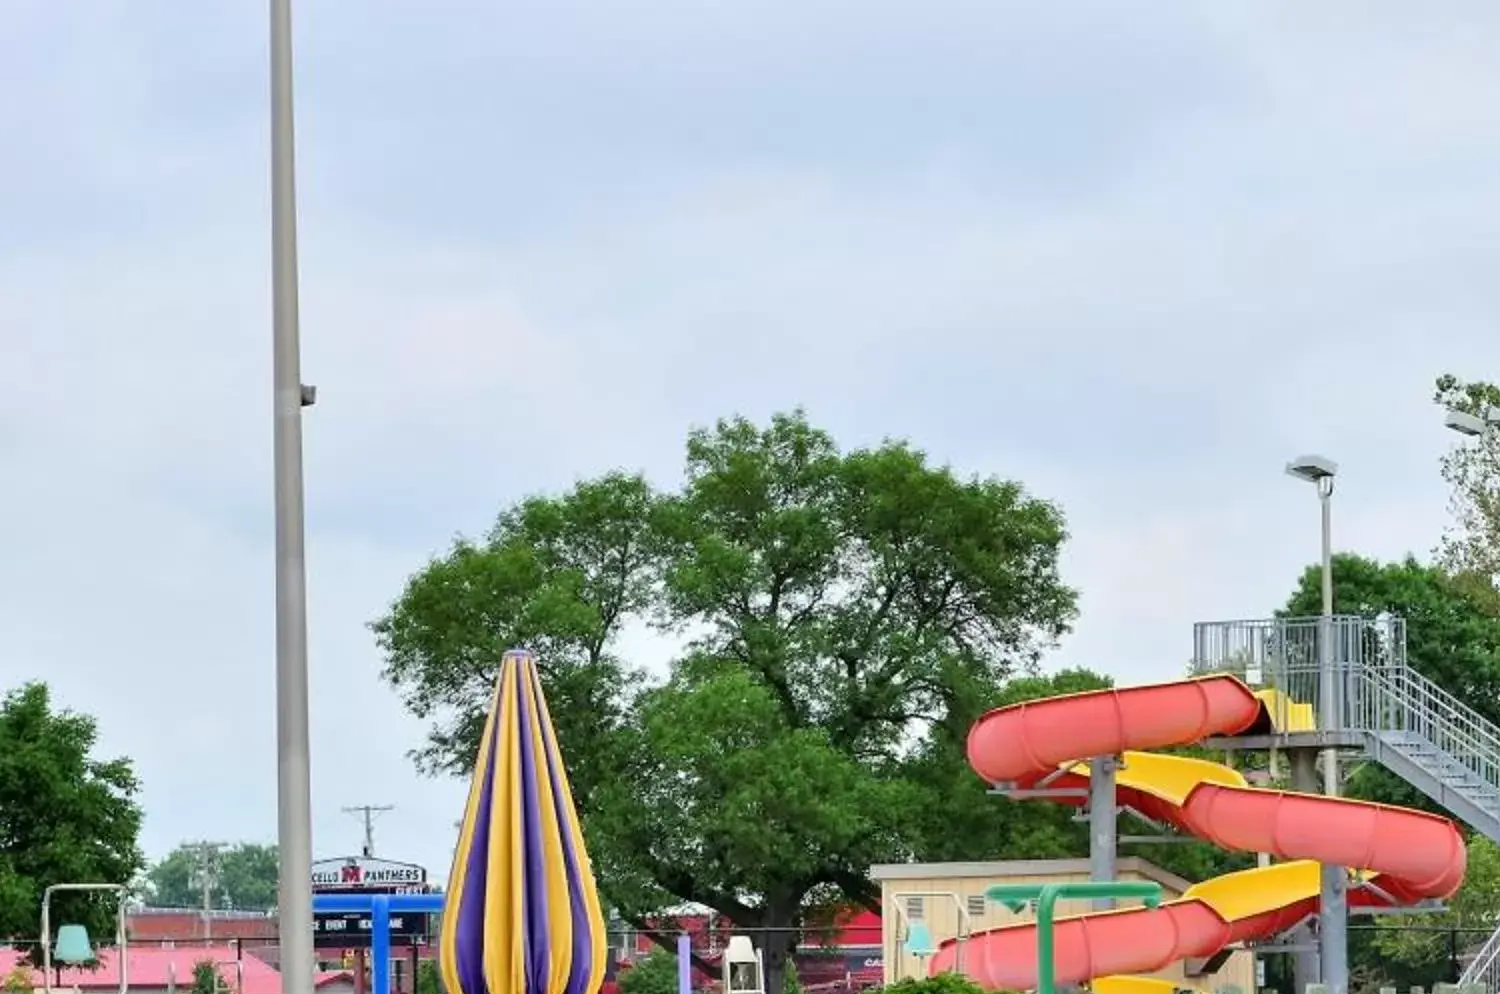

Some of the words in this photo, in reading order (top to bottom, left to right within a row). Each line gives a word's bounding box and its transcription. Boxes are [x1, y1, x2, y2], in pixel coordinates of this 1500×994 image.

[312, 871, 339, 882] CELLO
[364, 869, 419, 881] PANTHERS
[864, 958, 884, 967] CA
